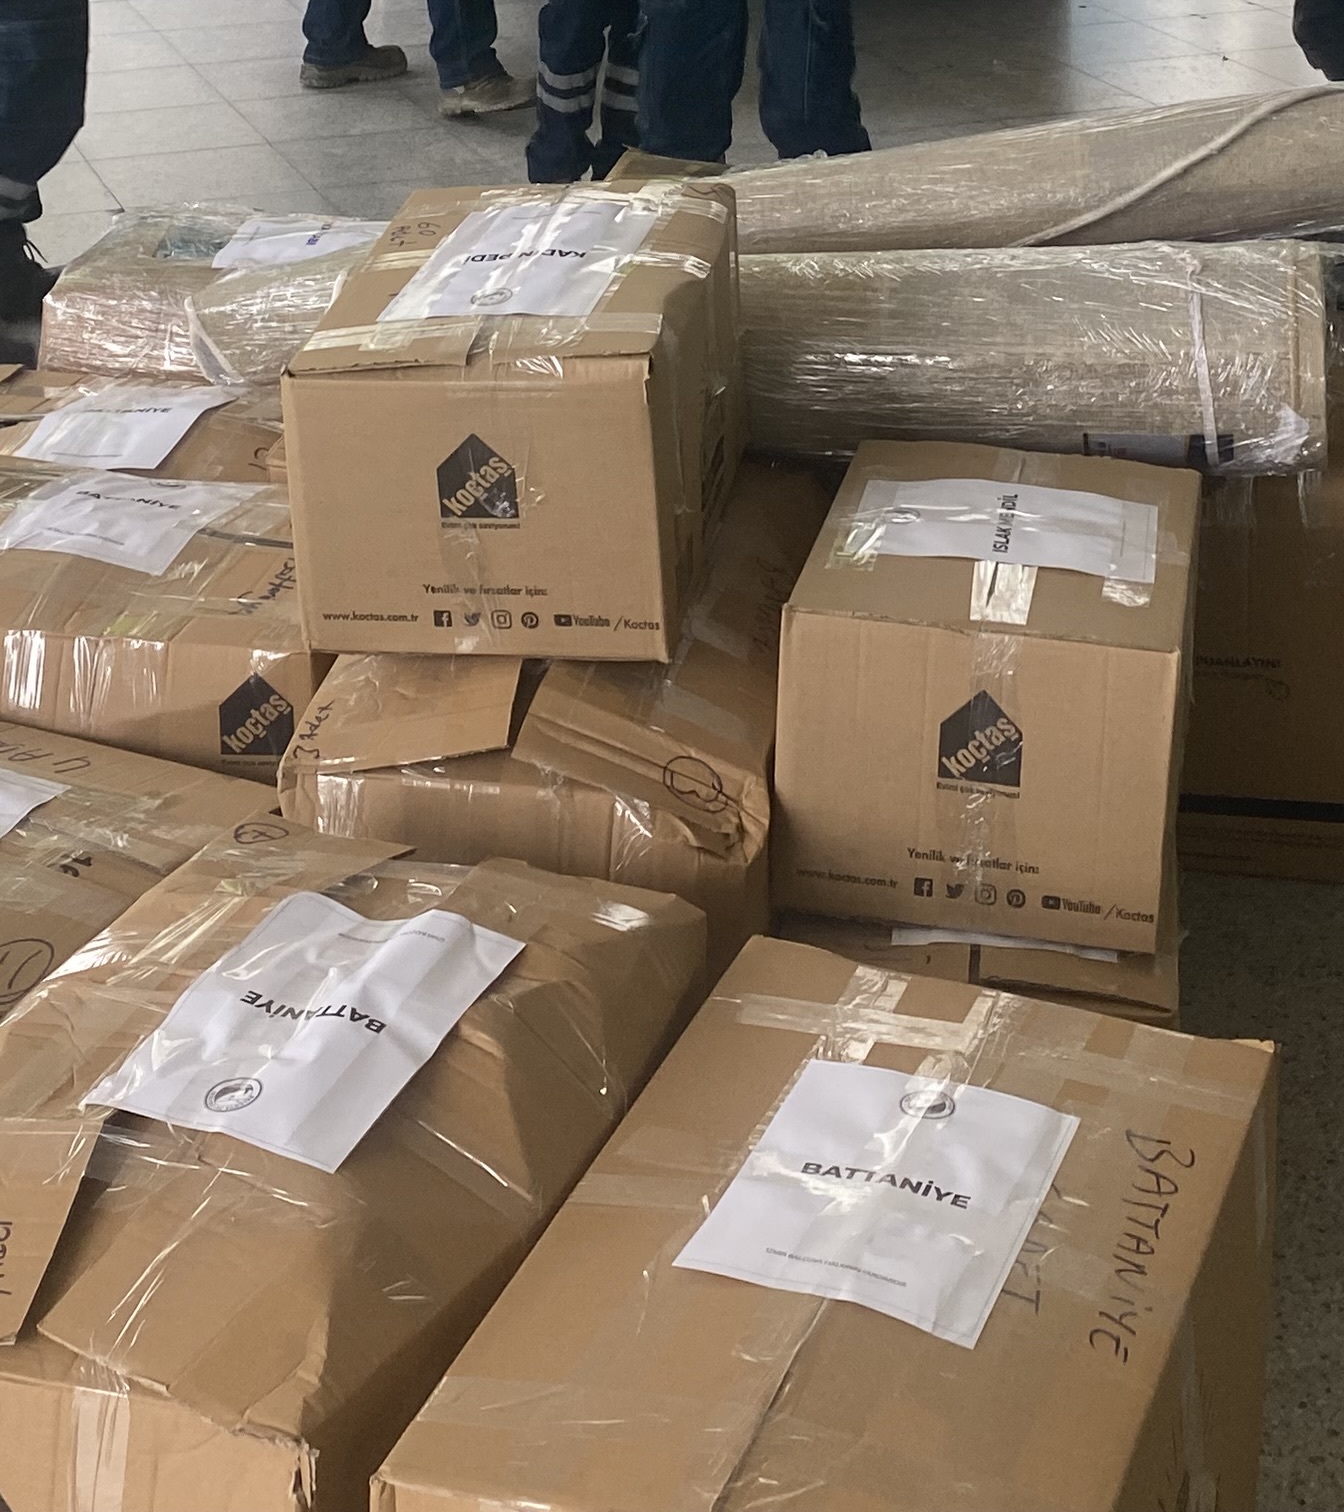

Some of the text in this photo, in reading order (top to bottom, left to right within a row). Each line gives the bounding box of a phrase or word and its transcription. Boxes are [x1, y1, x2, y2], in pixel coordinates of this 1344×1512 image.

[442, 455, 512, 517] koçtaş
[222, 692, 292, 754] koçtaş
[941, 716, 1019, 777] koçtaş
[907, 847, 946, 864] Yenilik
[240, 990, 388, 1034] BATTANİYE
[800, 1160, 972, 1210] BATTANİYE
[1090, 1127, 1196, 1365] BATTANİYE
